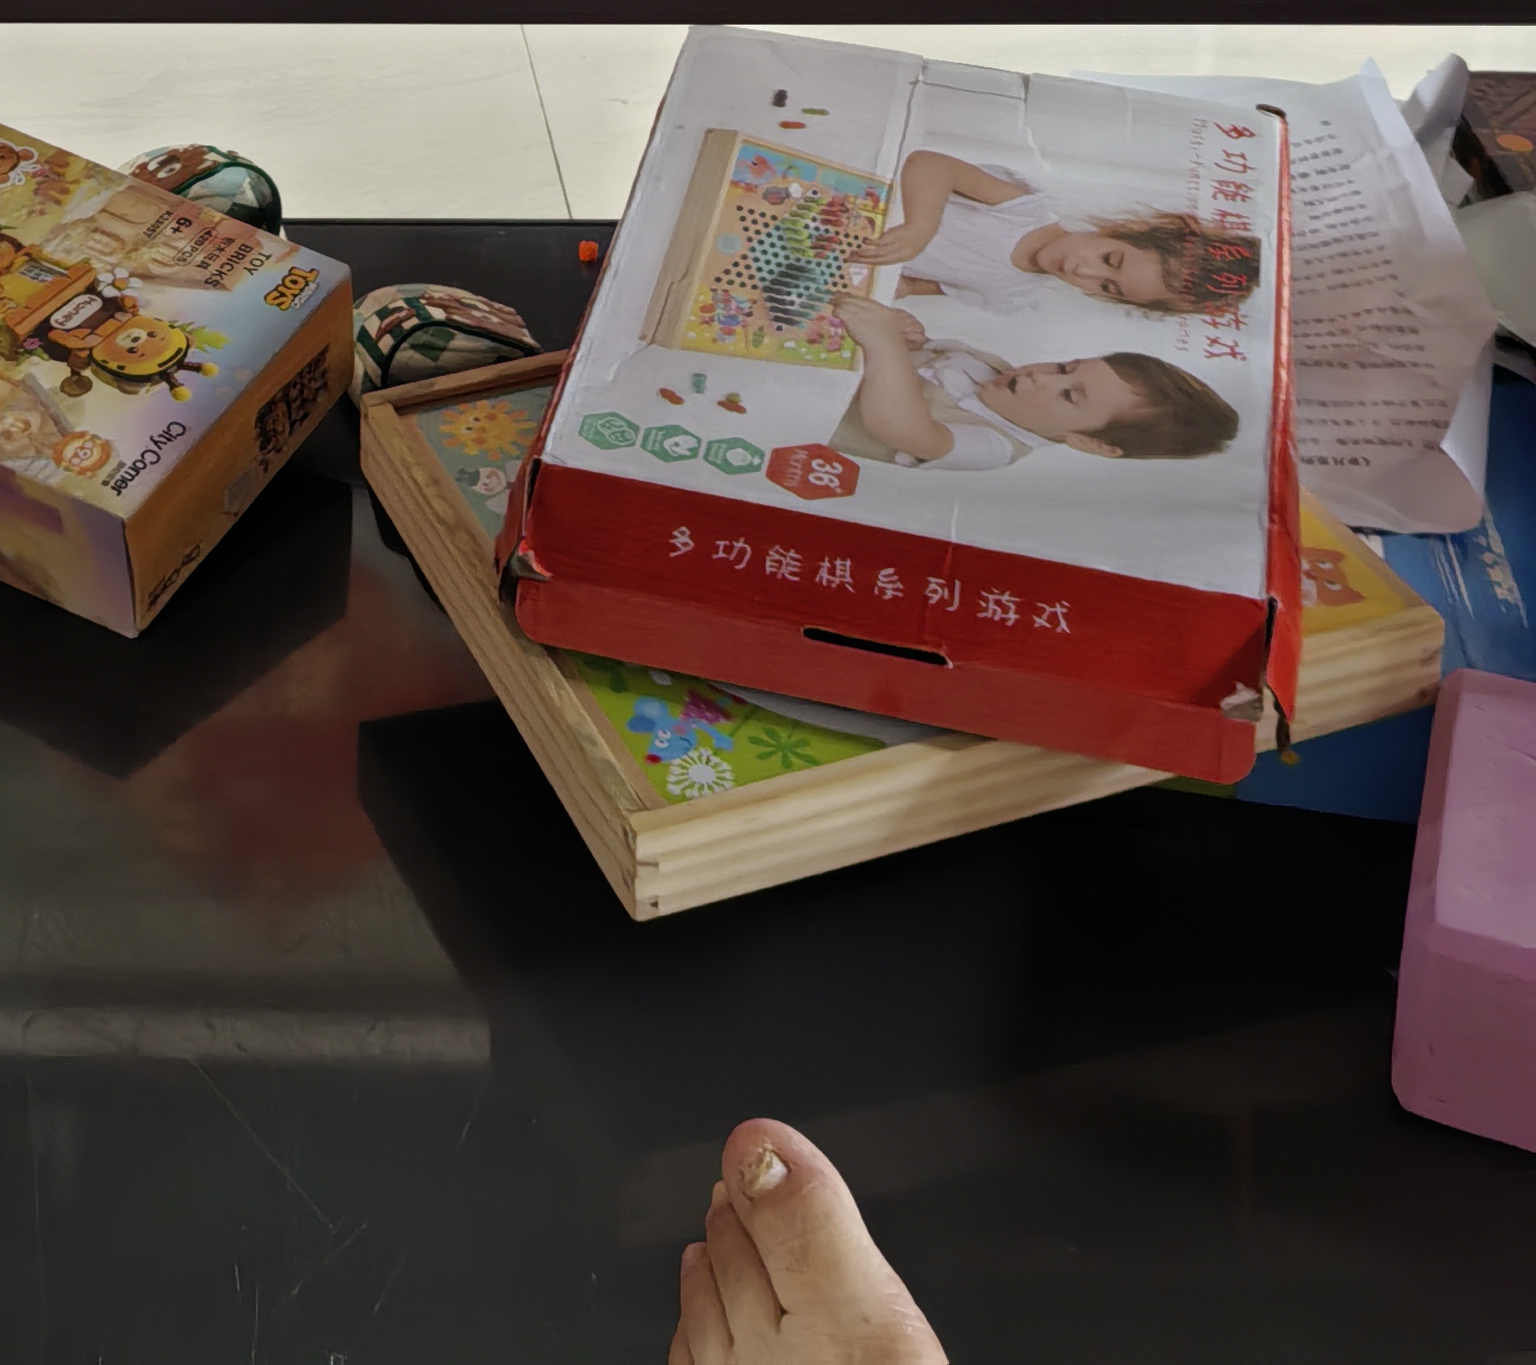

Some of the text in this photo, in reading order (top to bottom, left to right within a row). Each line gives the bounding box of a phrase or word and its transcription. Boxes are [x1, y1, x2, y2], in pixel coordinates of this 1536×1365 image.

[170, 216, 193, 235] 6+
[203, 243, 254, 288] BRICKS
[243, 252, 273, 276] TOY
[264, 266, 320, 311] TOYS
[58, 296, 99, 327] Honey
[149, 421, 187, 451] City
[111, 448, 162, 497] Corner
[669, 525, 1072, 635] 多功能棋系列游戏
